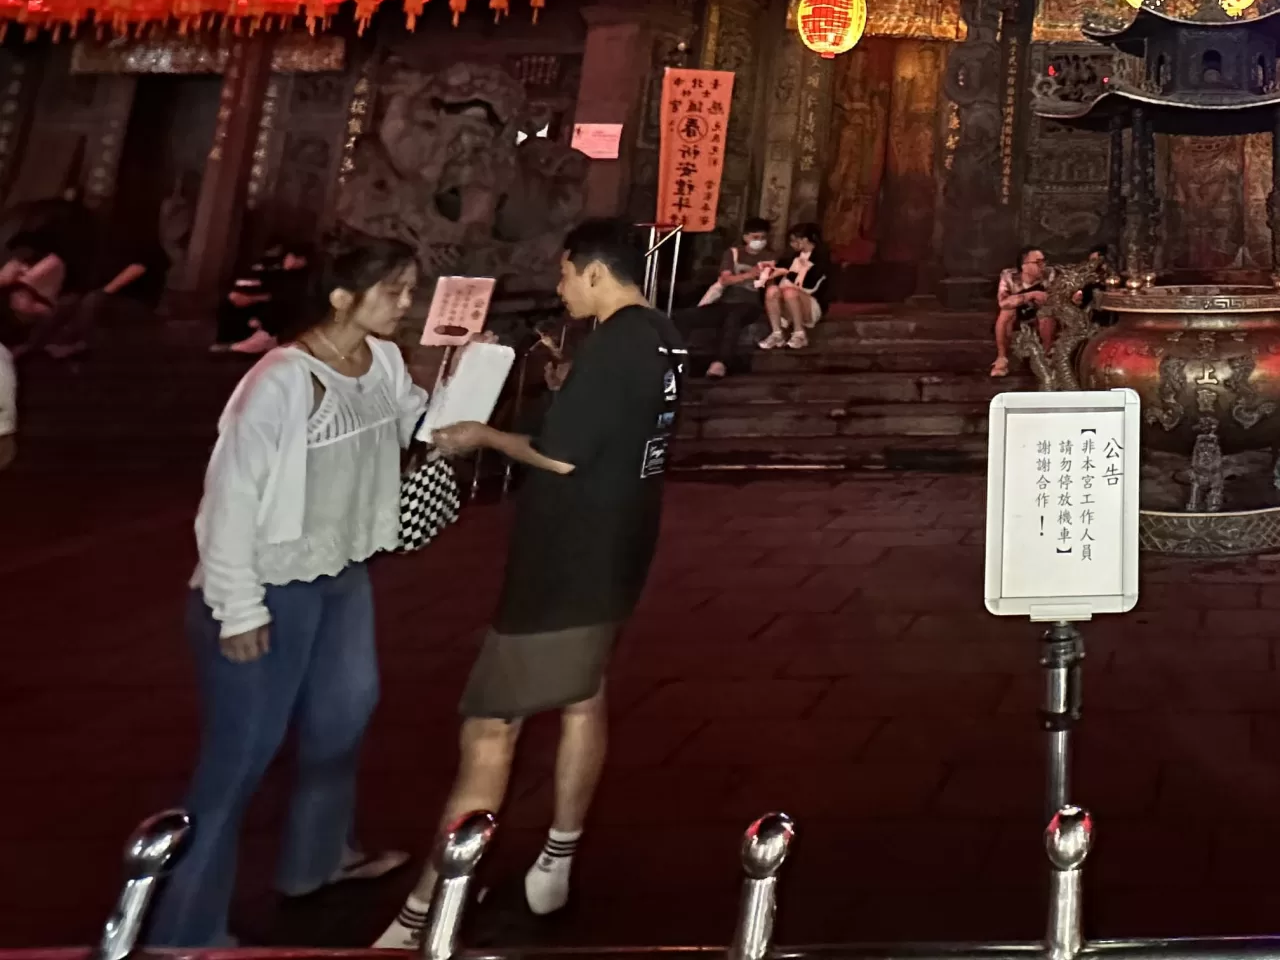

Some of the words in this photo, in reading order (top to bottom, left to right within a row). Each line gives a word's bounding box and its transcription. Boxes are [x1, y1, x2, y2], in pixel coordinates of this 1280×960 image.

[1035, 440, 1051, 537] 謝謝合作！
[1101, 437, 1124, 486] 公告
